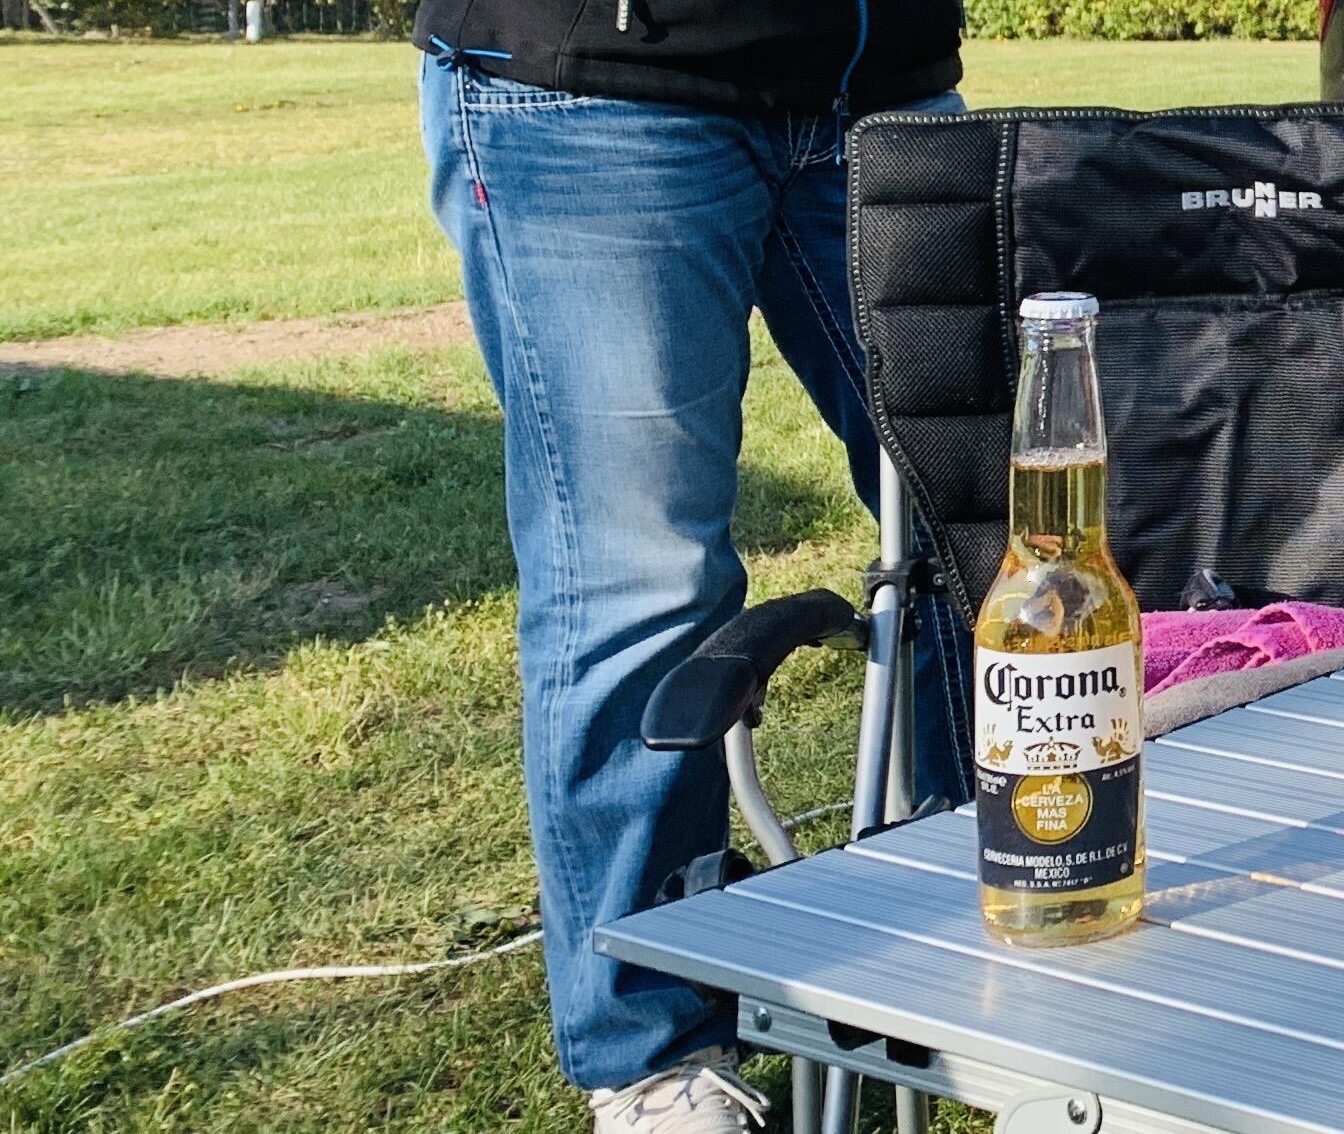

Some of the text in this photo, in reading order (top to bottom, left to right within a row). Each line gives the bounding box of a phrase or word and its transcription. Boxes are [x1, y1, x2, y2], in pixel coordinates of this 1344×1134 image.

[984, 662, 1120, 711] Corona
[1016, 705, 1095, 733] Extra
[1042, 783, 1061, 795] LA
[1021, 794, 1084, 807] CERVEZA
[1036, 807, 1067, 819] MAS
[1036, 819, 1068, 830] FINA
[1076, 852, 1088, 865] DE
[1034, 867, 1070, 879] MEXICO
